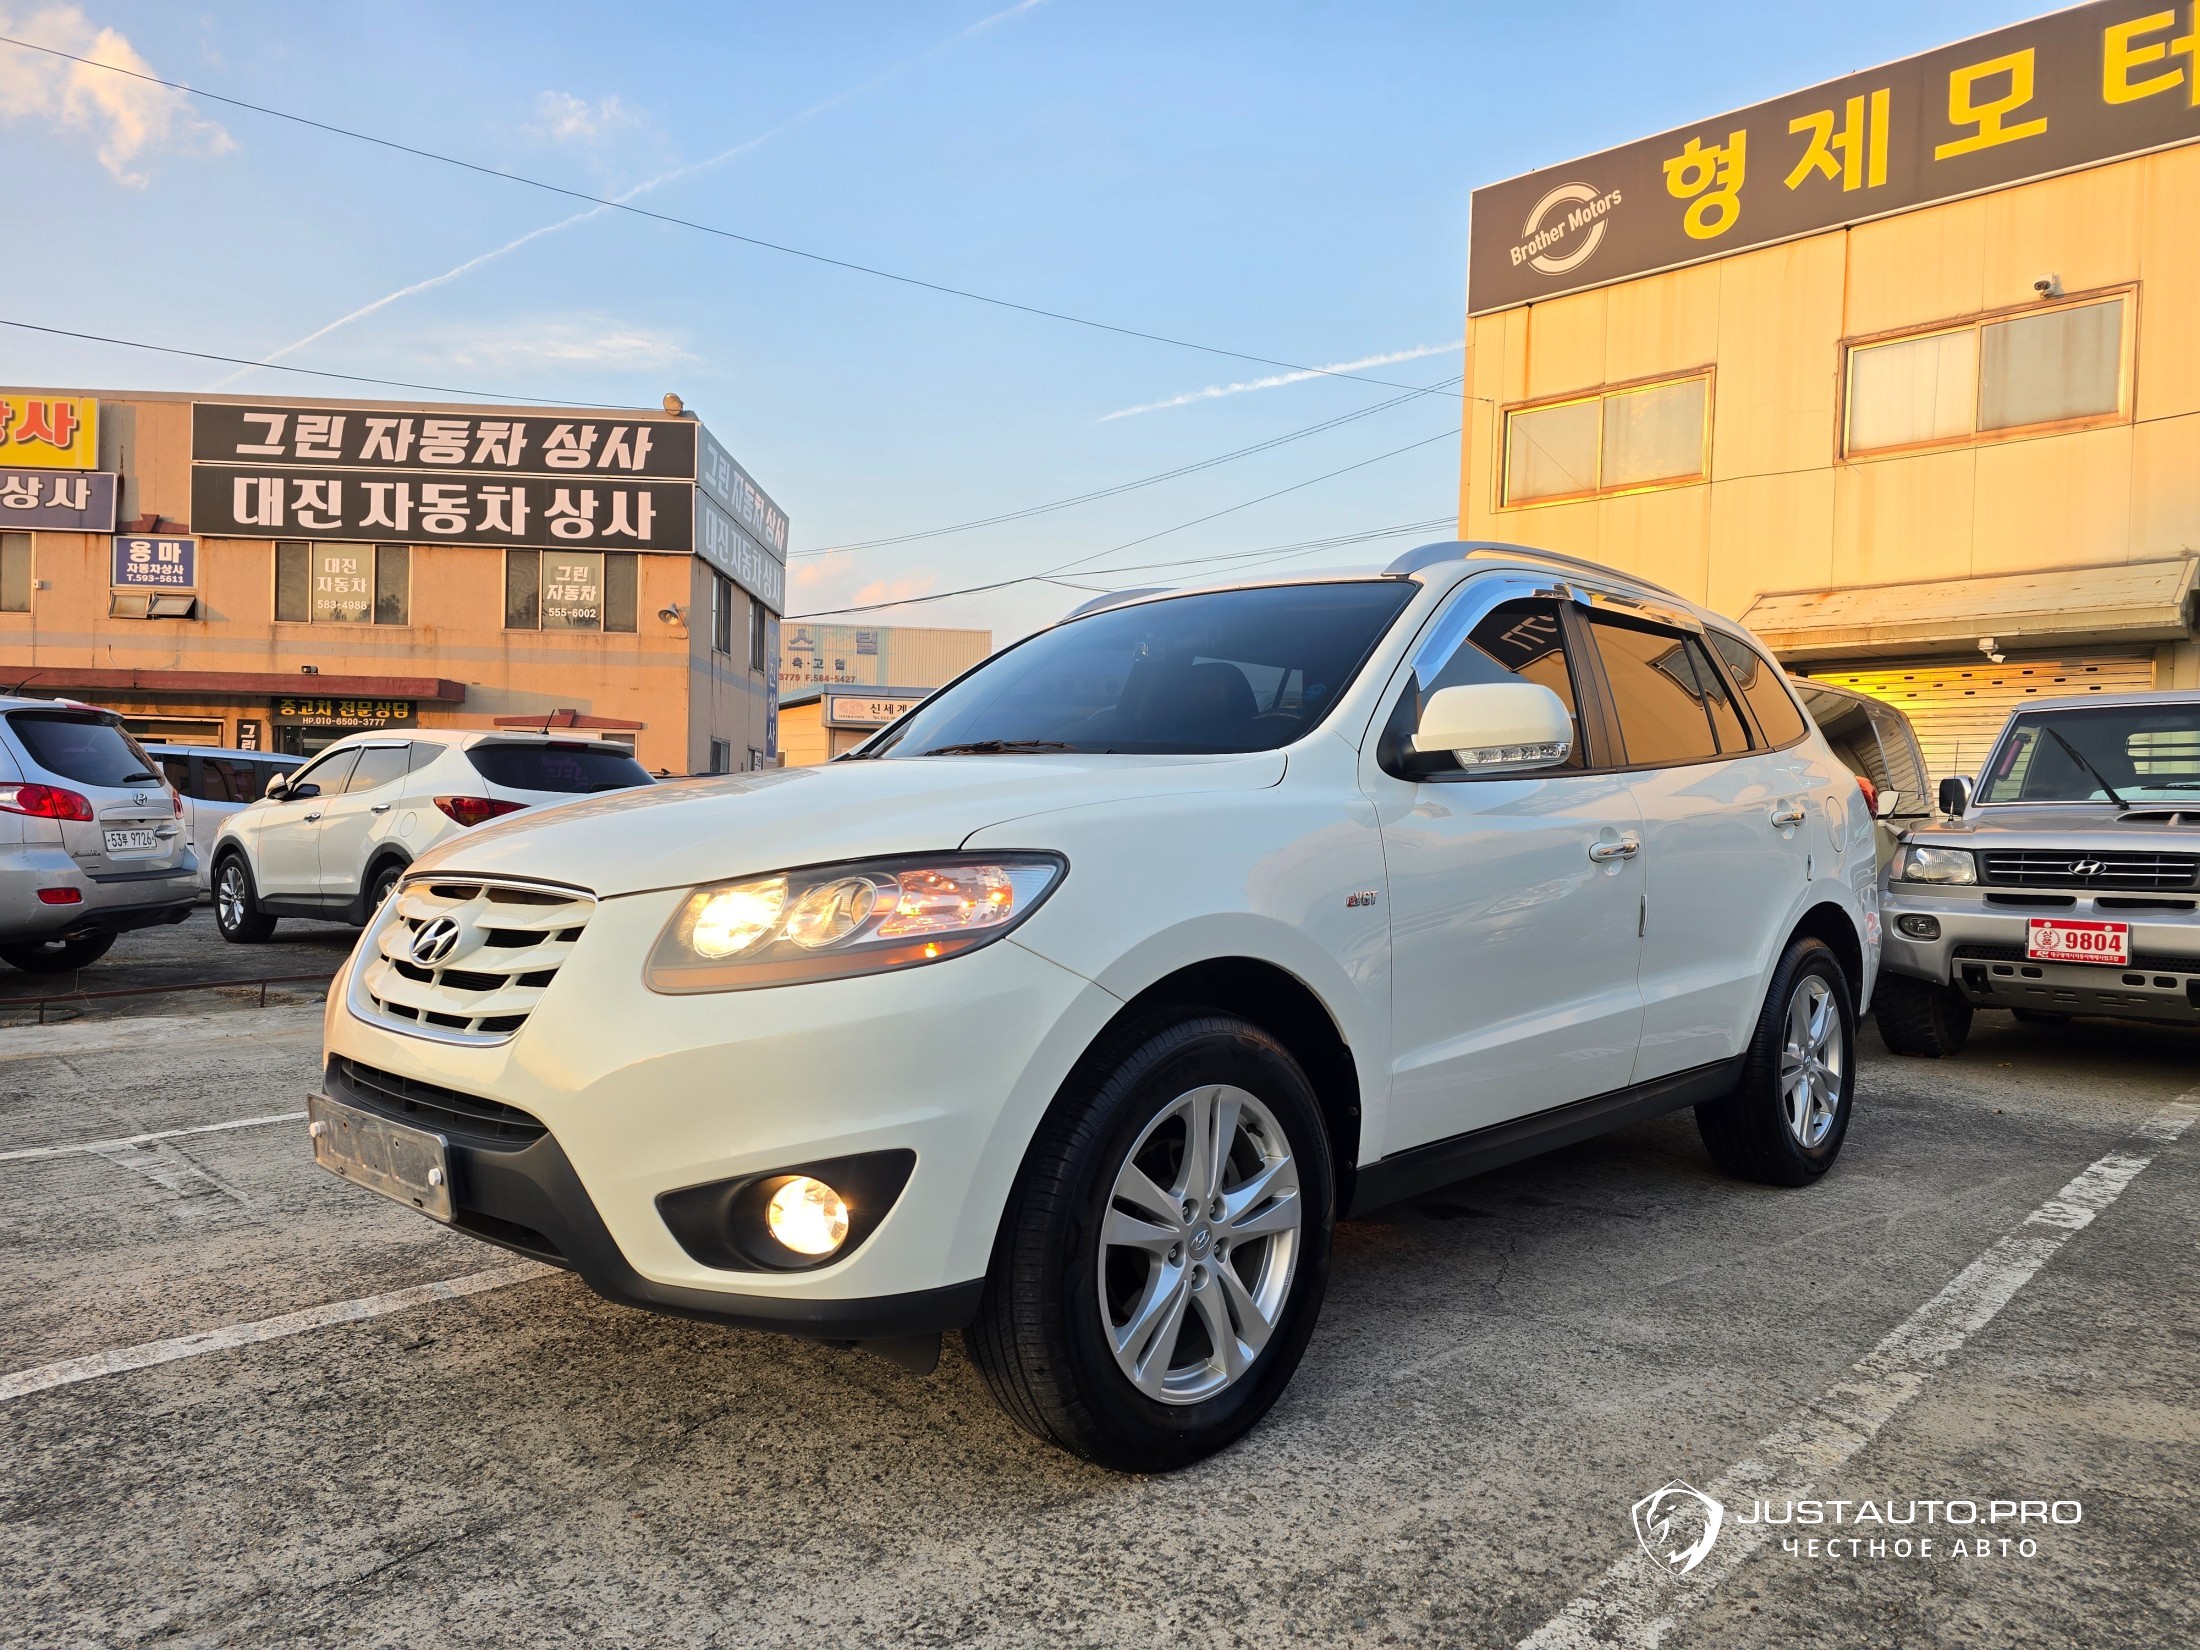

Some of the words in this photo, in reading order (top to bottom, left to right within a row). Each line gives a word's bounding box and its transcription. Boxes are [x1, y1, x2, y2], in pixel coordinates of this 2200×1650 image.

[1510, 222, 1565, 267] Brother
[1567, 190, 1622, 232] Motors
[0, 400, 76, 447] 사
[236, 412, 347, 459] 그린
[358, 417, 527, 467] 자동차
[541, 424, 653, 471] 상사
[0, 476, 91, 510] 상사
[705, 442, 730, 501] 그린
[731, 470, 764, 533] 자동차
[765, 505, 785, 553] 상사
[233, 477, 343, 529] 대진
[358, 481, 530, 535] 자동차
[544, 488, 656, 540] 상사
[705, 507, 729, 564] 대진
[731, 529, 761, 591] 자동차
[763, 560, 781, 605] 상사
[126, 562, 184, 575] 자동차상사
[324, 557, 357, 574] 대진
[556, 566, 589, 582] 그린
[126, 574, 184, 583] T.593-5611
[316, 576, 368, 593] 자동차
[546, 584, 597, 601] 자동차
[317, 600, 368, 611] 583-4988
[548, 607, 597, 618] 555-6002
[805, 673, 856, 684] F.584-5427
[280, 699, 332, 716] 중고차
[338, 701, 410, 719] 전문상담
[870, 703, 913, 715] 신세계
[302, 717, 386, 727] HP.010-6500-3777
[240, 724, 256, 750] 그린
[110, 833, 128, 847] 53루
[130, 832, 152, 847] 9726
[2065, 931, 2122, 952] 9804
